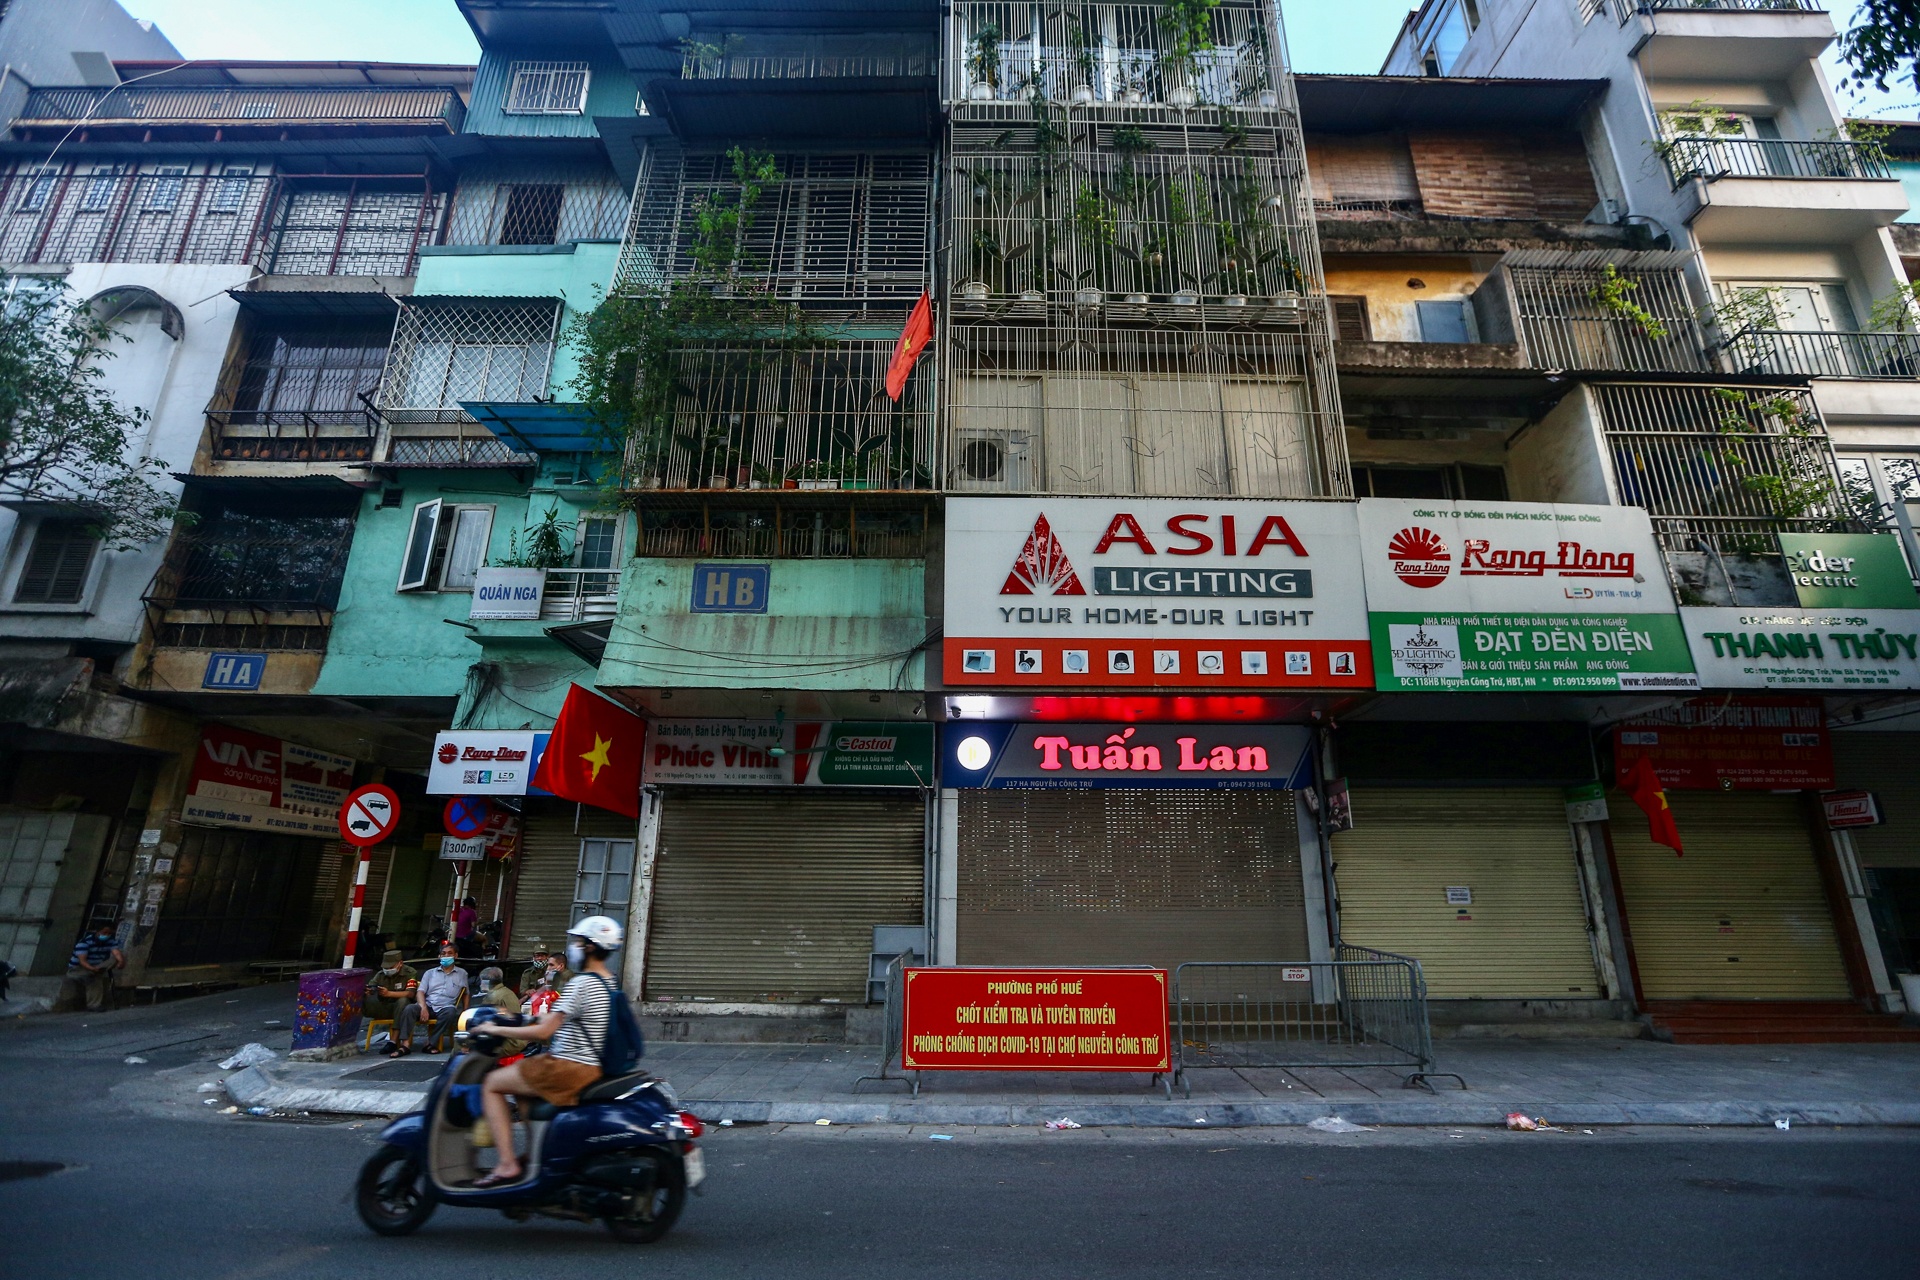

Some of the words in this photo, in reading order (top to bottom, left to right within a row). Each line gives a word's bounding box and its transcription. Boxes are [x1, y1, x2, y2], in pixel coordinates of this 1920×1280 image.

[1413, 509, 1435, 518] CÔNG
[1464, 510, 1486, 519] BÓNG
[1506, 511, 1528, 520] PHÍCH
[1555, 514, 1576, 523] RẠNG
[1579, 514, 1601, 522] ĐÔNG
[1093, 513, 1309, 557] ASIA
[1460, 539, 1546, 576] Rạng
[1557, 541, 1635, 578] Đông
[1110, 570, 1297, 593] LIGHTING
[479, 584, 512, 601] QUÂN
[513, 586, 537, 601] NGA
[1564, 587, 1594, 599] LED
[1620, 590, 1630, 598] TIN
[999, 606, 1072, 624] YOUR
[1238, 609, 1314, 626] LIGHT
[1463, 614, 1480, 626] PHỐI
[1482, 614, 1501, 626] THIẾT
[1514, 616, 1530, 627] ĐIỆN
[1474, 630, 1524, 656] ĐẠT
[1531, 627, 1587, 652] ĐÈN
[1591, 627, 1654, 656] ĐIỆN
[1703, 632, 1824, 658] THANH
[1407, 650, 1456, 659] LIGHTING
[1461, 658, 1478, 670] BÁN
[1480, 661, 1487, 670] &
[1488, 657, 1505, 670] GIỚI
[1508, 659, 1531, 671] THIỆU
[1553, 657, 1578, 670] PHẨM
[1605, 658, 1629, 670] ĐÔNG
[1401, 677, 1413, 686] ĐC:
[1415, 677, 1439, 686] 118HB
[1470, 677, 1489, 688] Công
[1506, 677, 1524, 687] HBT,
[1524, 677, 1536, 686] HN
[1553, 677, 1566, 686] ĐT:
[1567, 677, 1586, 686] 0912
[1586, 677, 1601, 686] 950
[1602, 677, 1616, 686] 099
[657, 724, 671, 736] Bán
[695, 725, 709, 737] Bán
[722, 725, 736, 739] Phụ
[738, 725, 756, 740] Tùng
[757, 725, 767, 737] Xe
[850, 738, 892, 750] Castrol
[1033, 727, 1162, 772] Tuấn
[1176, 736, 1270, 772] Lan
[654, 743, 715, 768] Phúc
[1059, 779, 1078, 787] CÔNG
[1833, 802, 1862, 817] Himel
[448, 843, 476, 854] 300m
[988, 981, 1033, 995] PHƯỜNG
[1035, 980, 1058, 995] PHỐ
[1061, 979, 1083, 995] HUẾ
[956, 1001, 981, 1024] CHỐT
[983, 1001, 1008, 1024] KIỂM
[1010, 1007, 1028, 1024] TRA
[1031, 1004, 1044, 1024] VÀ
[1046, 1004, 1077, 1025] TUYÊN
[1078, 1002, 1116, 1025] TRUYỀN
[913, 1031, 943, 1053] PHÒNG
[945, 1030, 975, 1053] CHỐNG
[977, 1035, 998, 1056] DỊCH
[1000, 1035, 1040, 1054] COVID-19
[1042, 1036, 1056, 1057] TẠI
[1058, 1035, 1076, 1057] CHỢ
[1078, 1031, 1113, 1054] NGUYỄN
[1115, 1034, 1140, 1054] CÔNG
[1141, 1034, 1159, 1055] TRỨ
